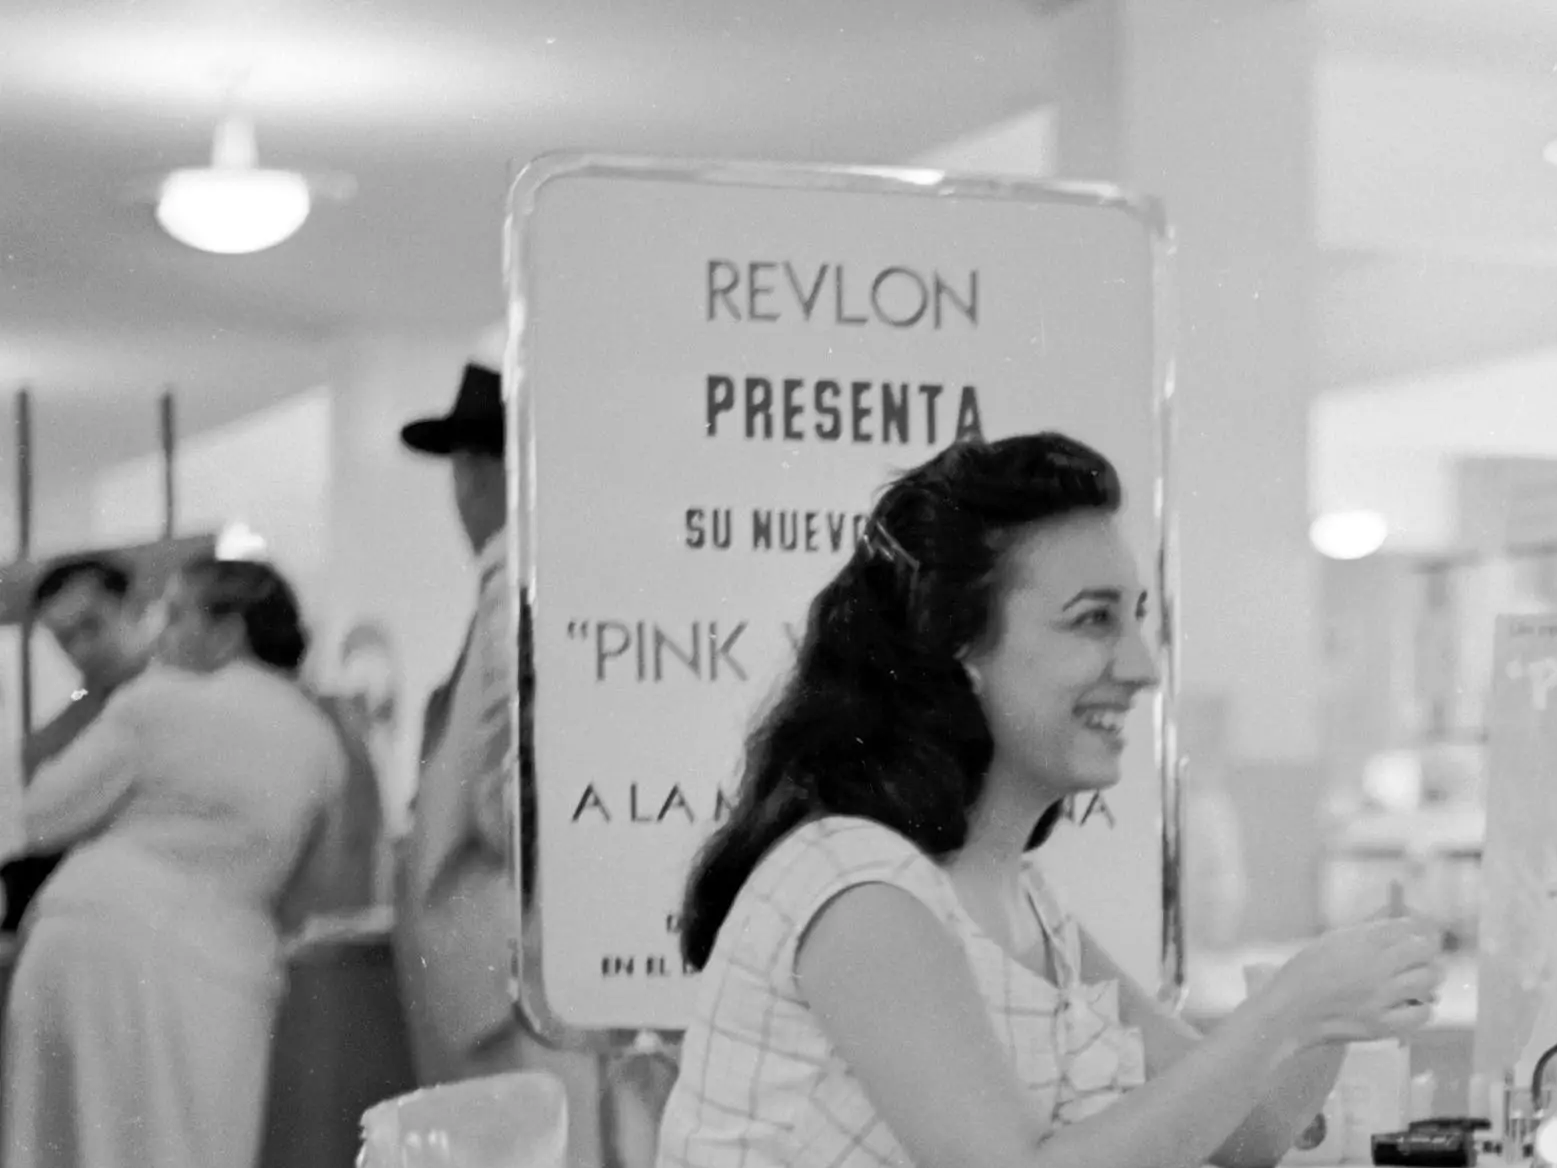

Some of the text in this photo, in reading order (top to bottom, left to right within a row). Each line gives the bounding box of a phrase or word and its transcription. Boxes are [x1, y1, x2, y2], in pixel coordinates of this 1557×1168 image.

[705, 258, 979, 330] REVLON
[706, 375, 986, 446] PRESENTA
[685, 507, 732, 551] SU
[566, 618, 749, 683] "PINK
[572, 781, 612, 823] A
[629, 782, 696, 824] LA
[601, 955, 635, 977] EN
